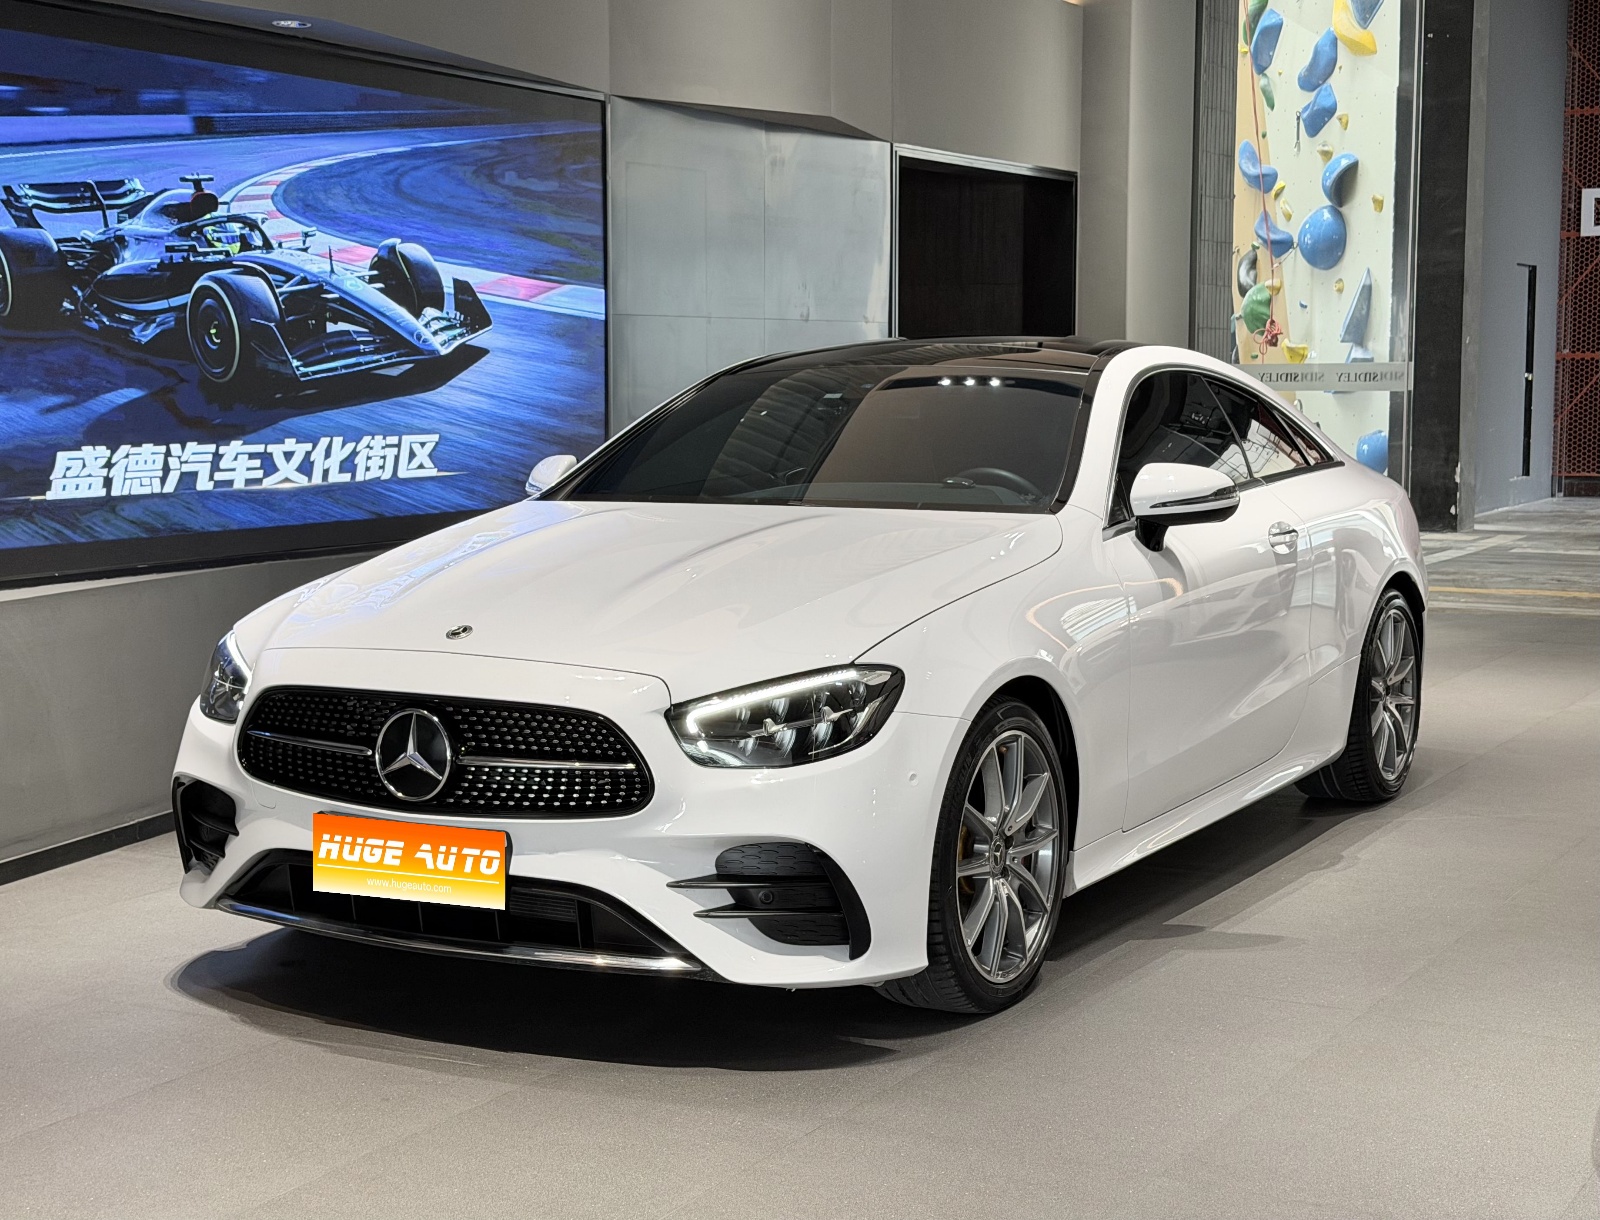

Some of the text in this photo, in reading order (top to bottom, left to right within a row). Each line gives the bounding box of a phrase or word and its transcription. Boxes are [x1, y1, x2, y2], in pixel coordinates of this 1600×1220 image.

[46, 433, 440, 500] 盛德汽车文化街区
